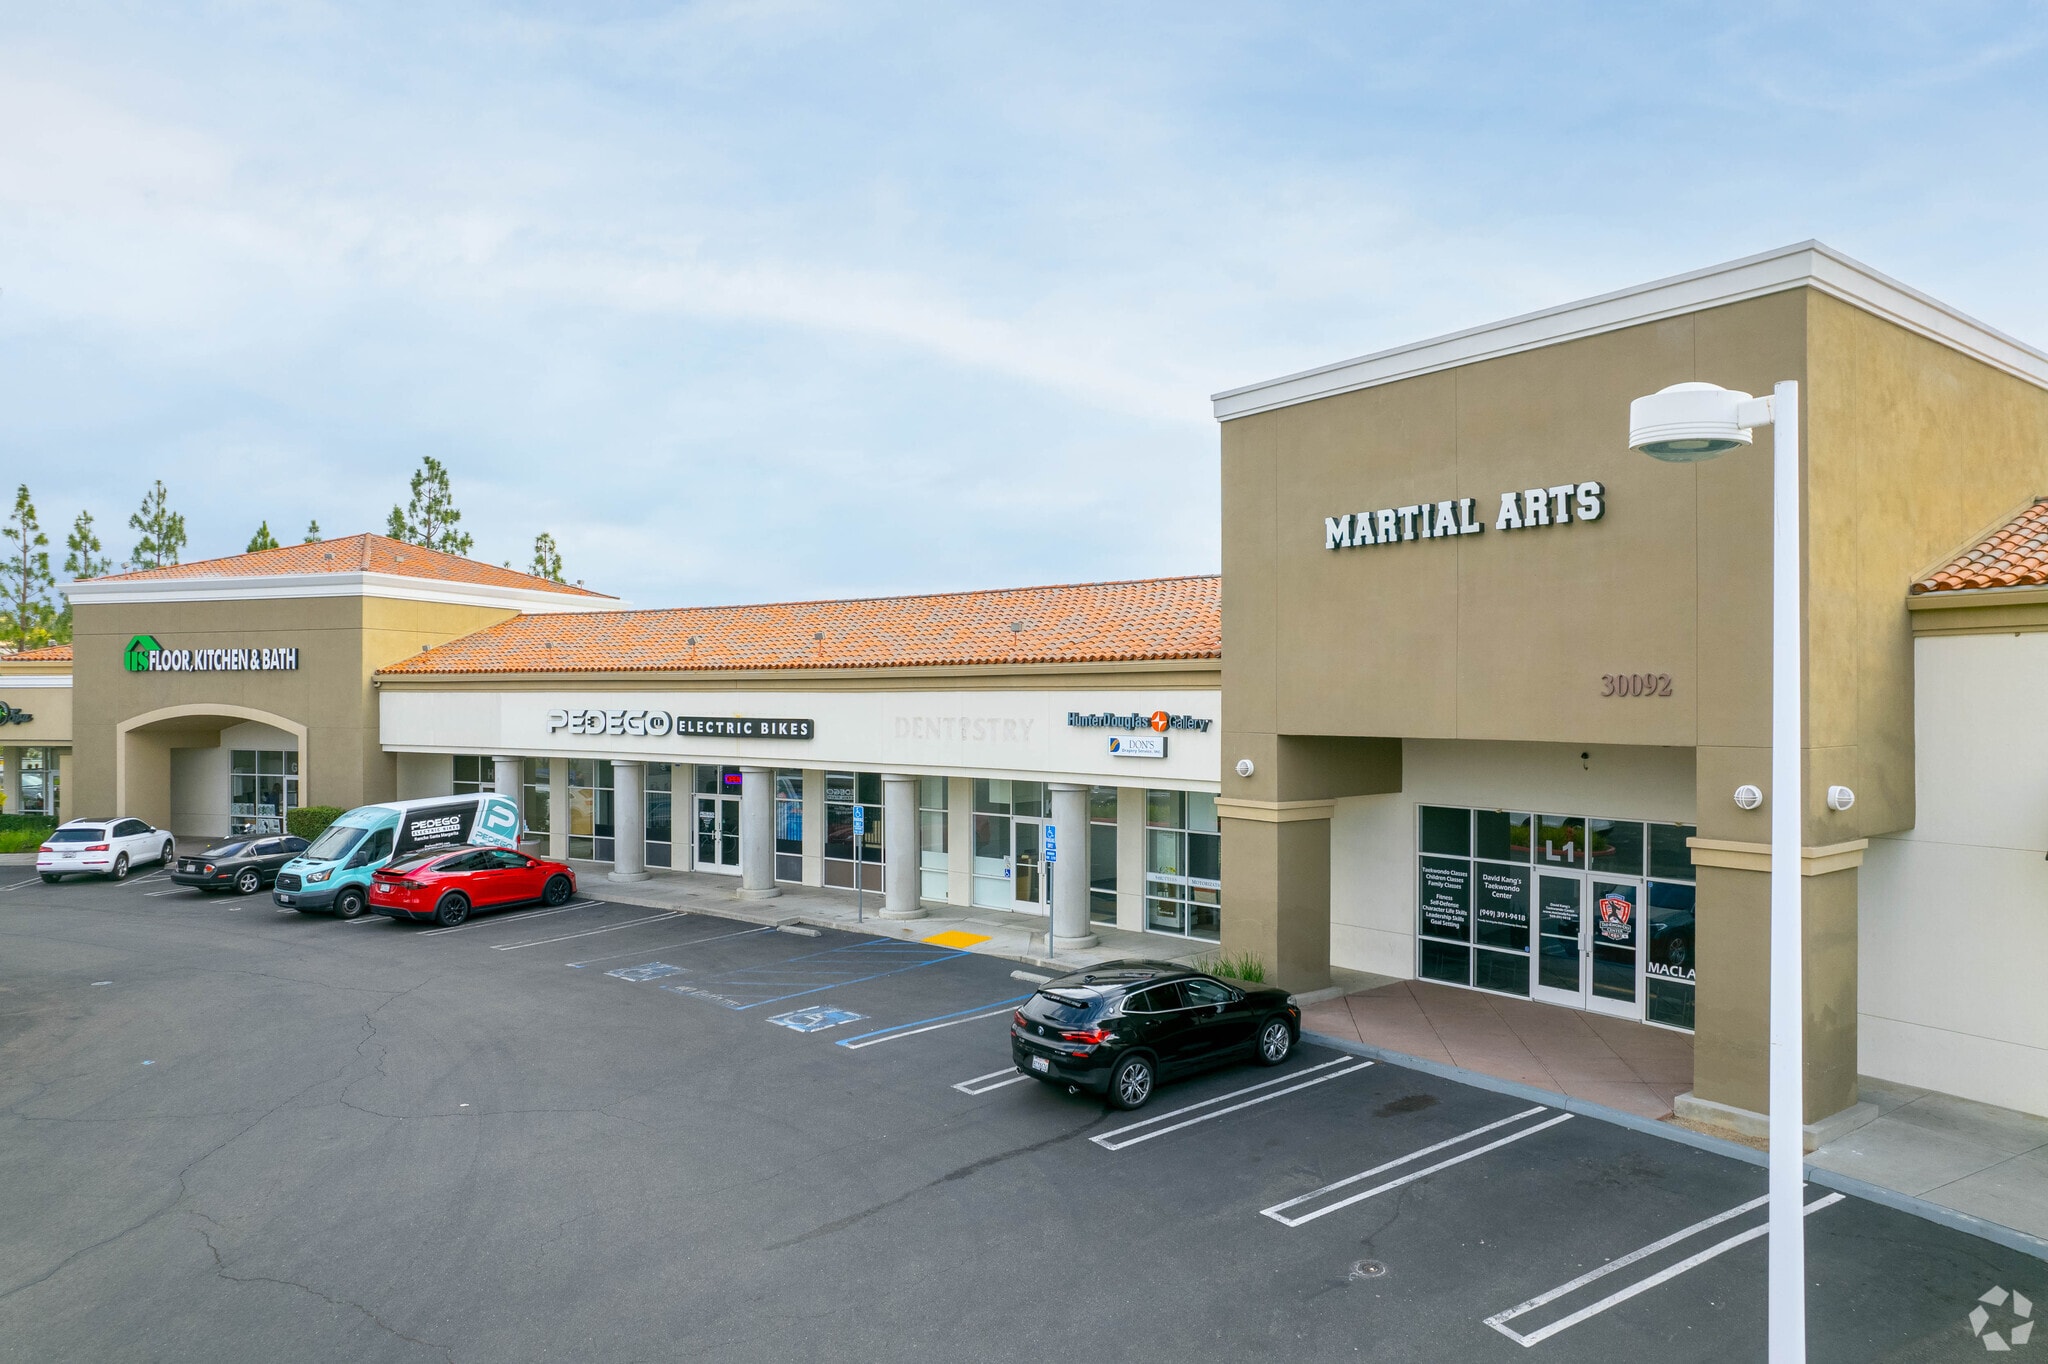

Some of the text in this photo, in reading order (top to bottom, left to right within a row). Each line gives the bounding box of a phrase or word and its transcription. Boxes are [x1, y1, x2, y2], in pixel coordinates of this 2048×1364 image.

[1325, 481, 1605, 550] MARTIAL ARTS
[149, 650, 194, 672] FLOOR,
[195, 649, 249, 671] KITCHEN
[250, 649, 260, 670] &
[262, 648, 297, 671] BATH
[1601, 672, 1673, 698] 30092
[546, 709, 673, 736] PEDEGO
[679, 719, 808, 736] ELECTRIC BIKES
[291, 762, 298, 773] G
[411, 816, 460, 830] PEDEGO
[412, 827, 441, 836] ELECTRIC
[1546, 840, 1574, 863] L1
[1423, 867, 1450, 875] Taekwondo
[1428, 880, 1443, 888] Family
[1501, 876, 1522, 885] Kang's
[1484, 882, 1520, 892] Taekwondo
[1492, 891, 1512, 899] Center
[1426, 912, 1451, 921] Leadership
[1479, 909, 1526, 921] (949) 391-9418
[1442, 921, 1460, 929] Setting
